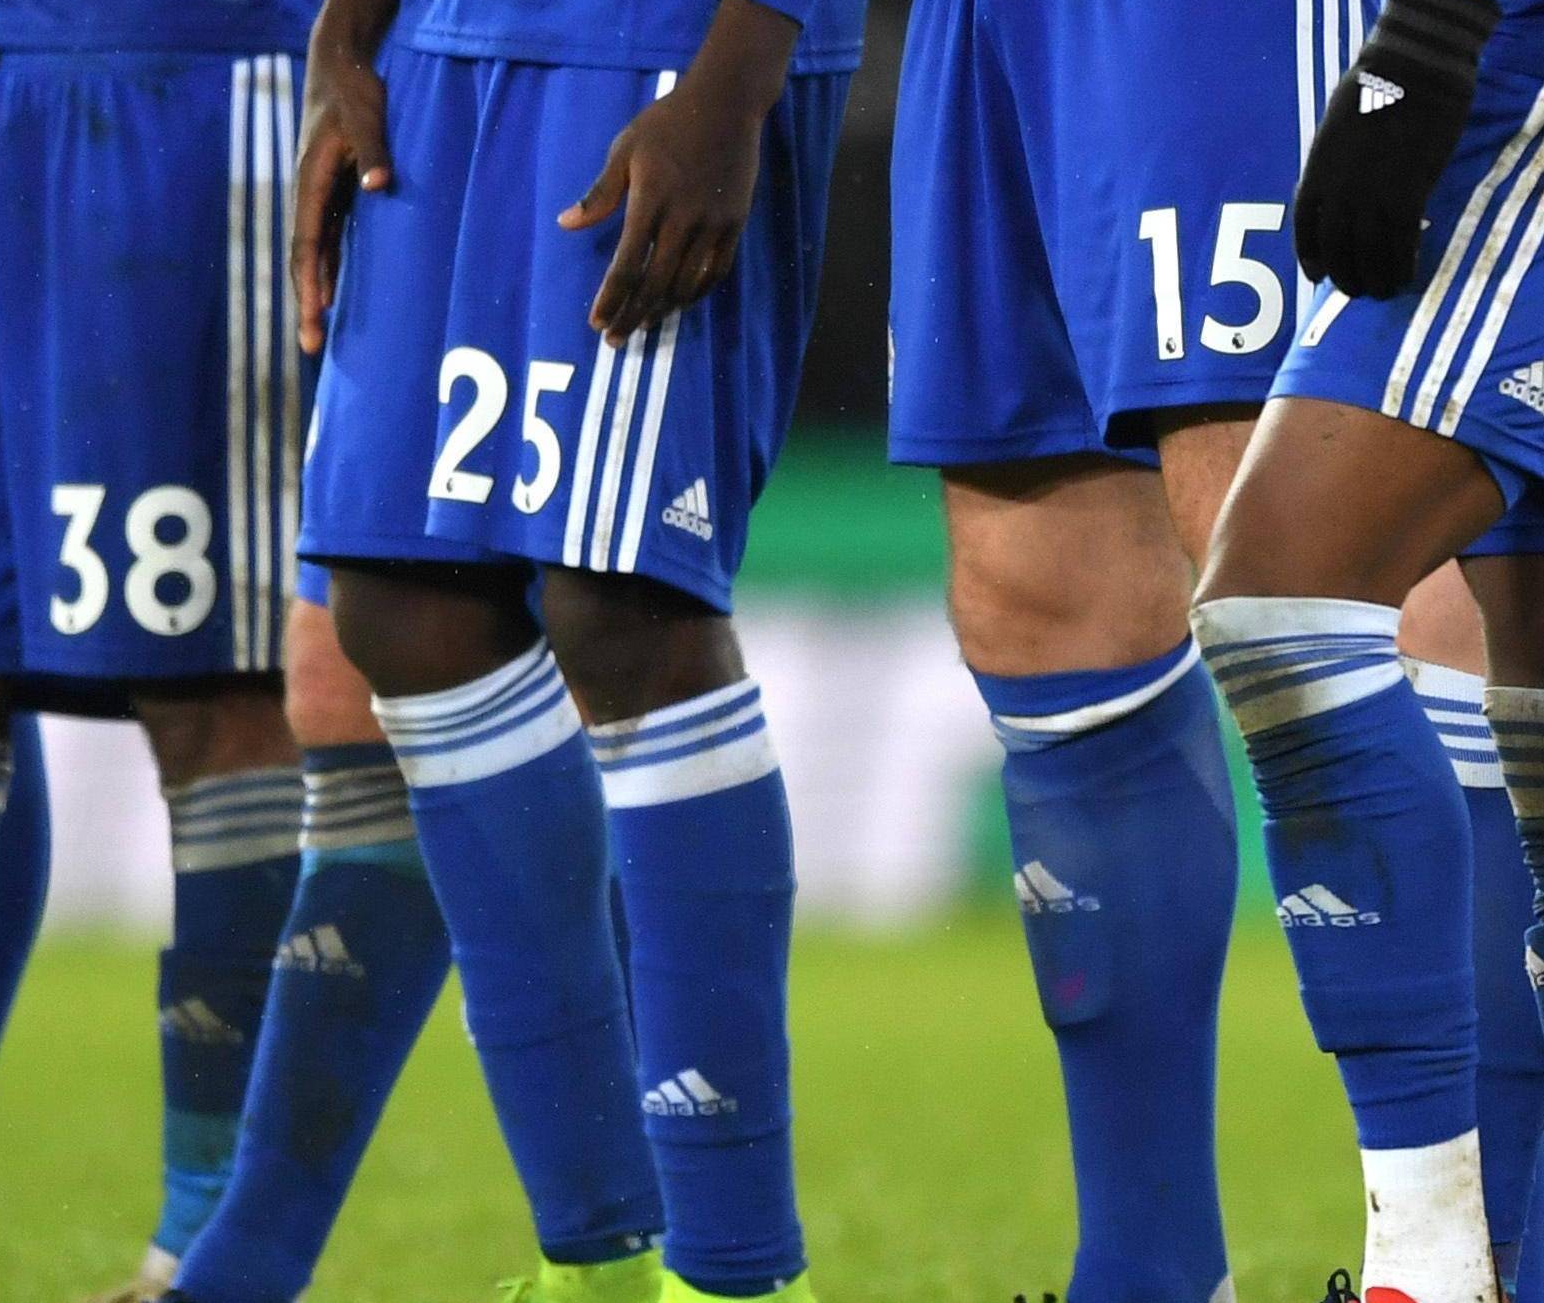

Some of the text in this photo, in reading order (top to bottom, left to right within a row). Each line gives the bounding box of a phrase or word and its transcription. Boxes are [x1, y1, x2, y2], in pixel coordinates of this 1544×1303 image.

[1138, 202, 1286, 361] 15
[427, 345, 576, 514] 25
[50, 483, 218, 636] 38
[1277, 910, 1382, 928] didas
